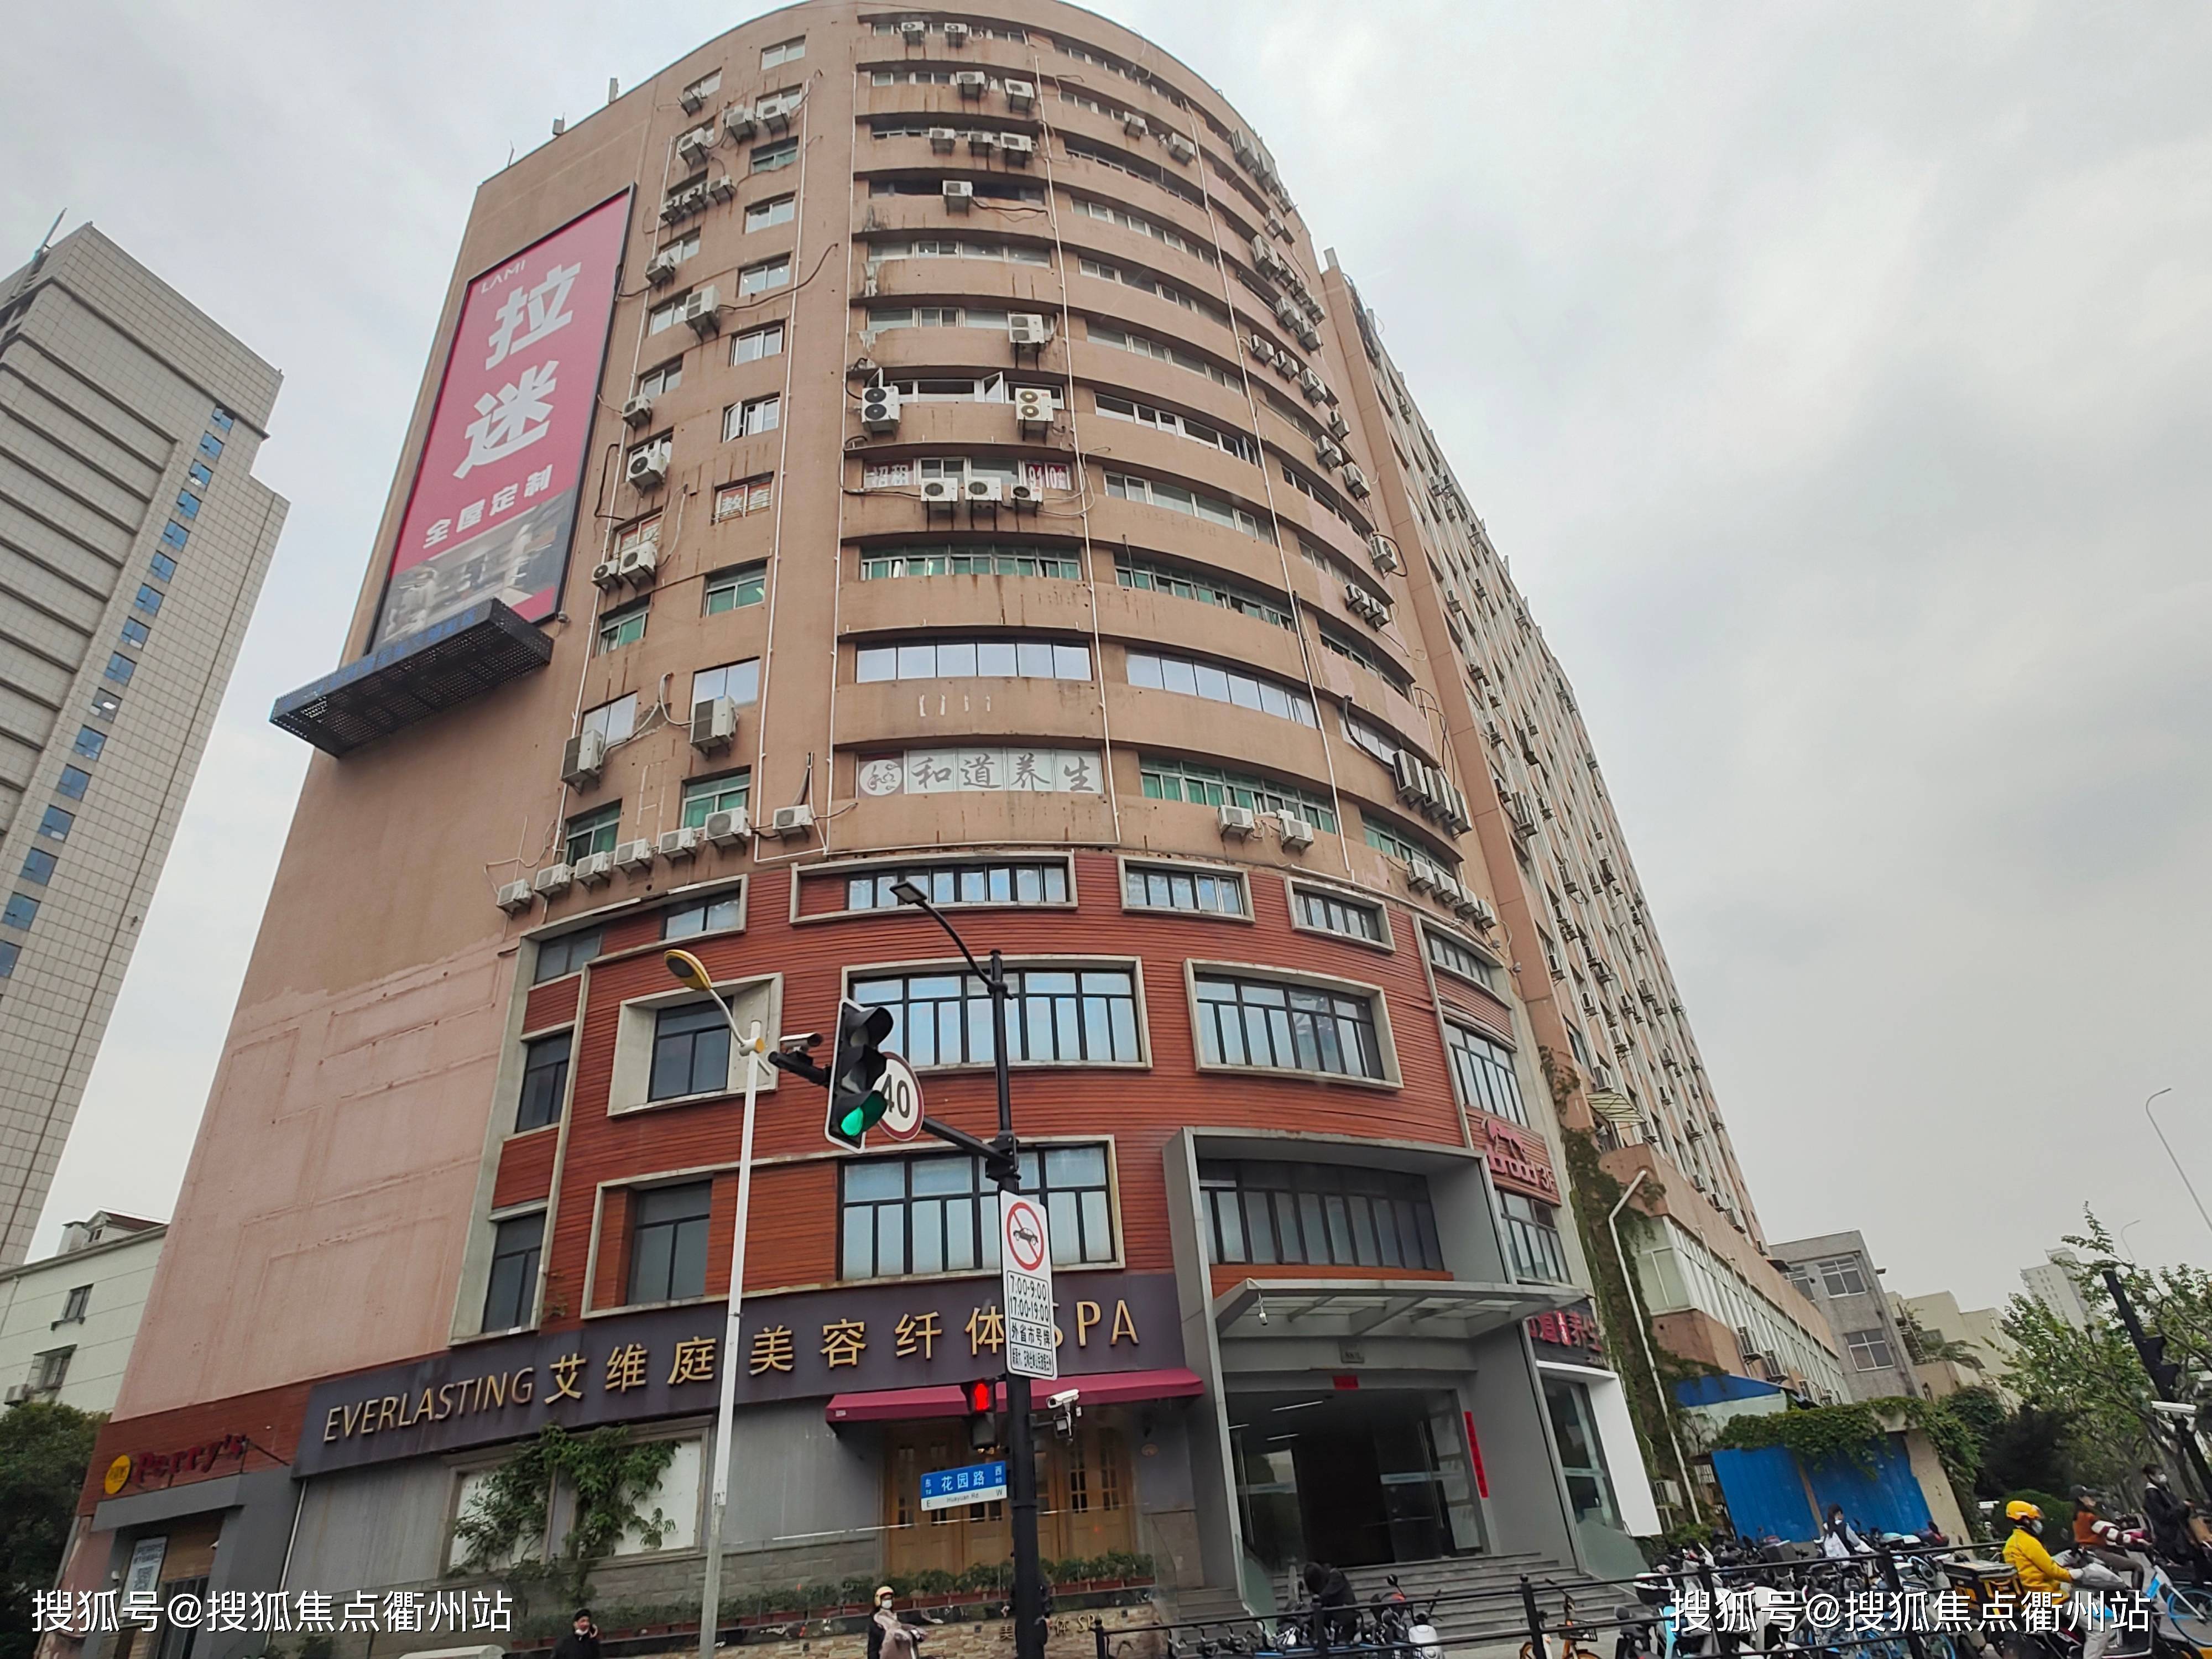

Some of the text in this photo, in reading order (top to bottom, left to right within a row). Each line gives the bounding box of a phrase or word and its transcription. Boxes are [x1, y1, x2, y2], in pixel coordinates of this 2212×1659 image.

[481, 259, 525, 294] LAMI
[453, 262, 581, 479] 拉迷
[422, 463, 552, 549] 全屋定制
[910, 753, 1095, 793] 和道养生
[881, 1073, 910, 1119] 40
[1010, 1275, 1047, 1301] 7:00-9:00
[1010, 1296, 1049, 1322] 17:00-19:00
[1011, 1322, 1051, 1348] 外省市号牌
[323, 1300, 1139, 1443] EVERLASTING 艾维庭美容纤体 PA
[941, 1470, 984, 1492] 花园路
[947, 1495, 969, 1504] Huayuan
